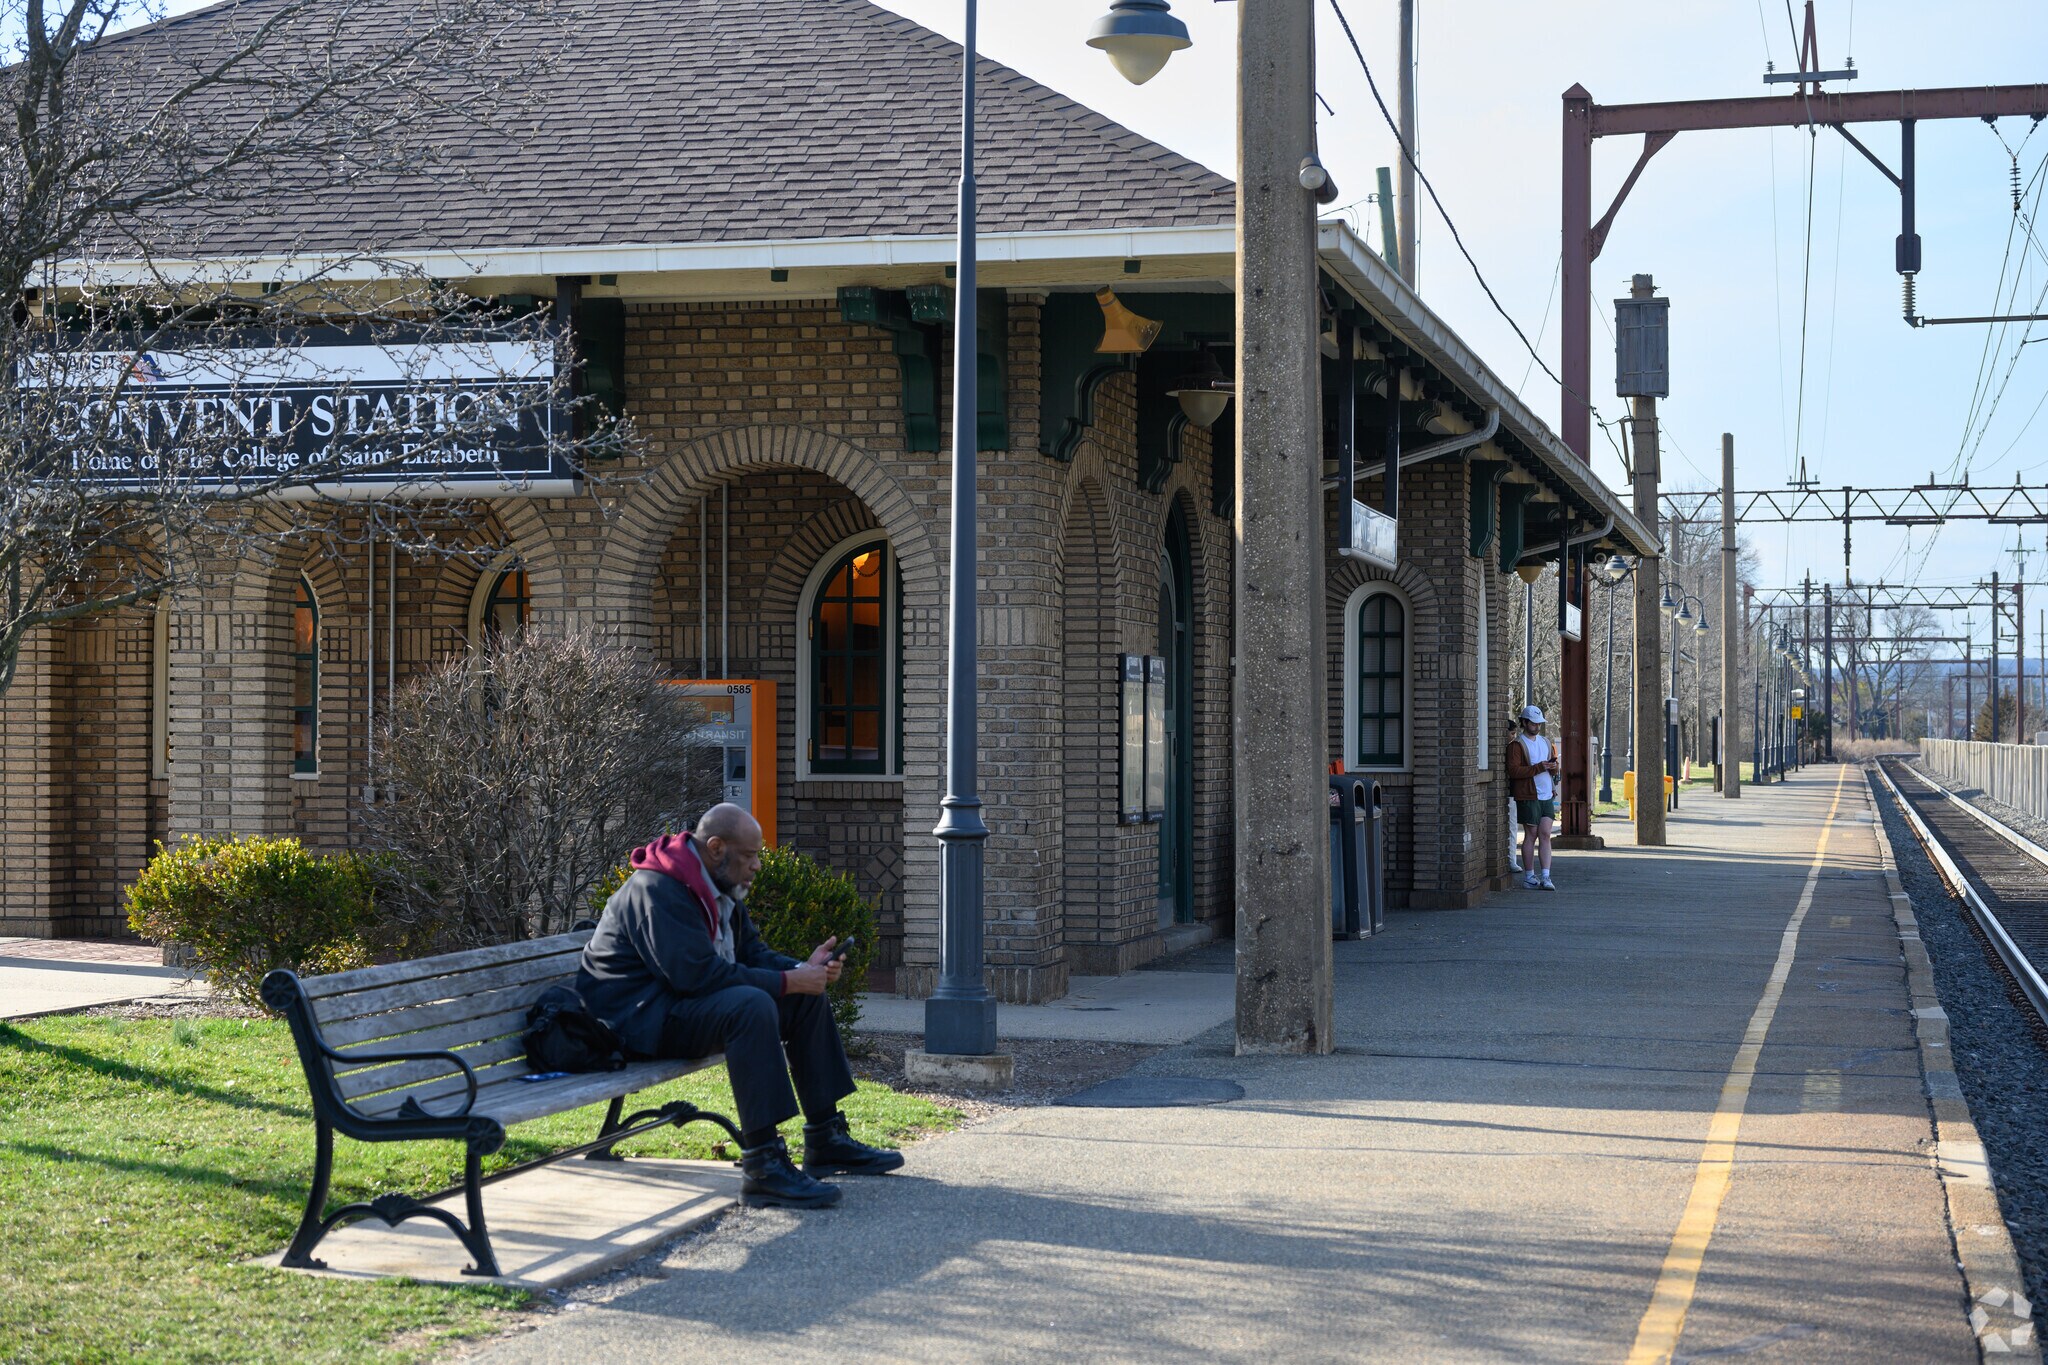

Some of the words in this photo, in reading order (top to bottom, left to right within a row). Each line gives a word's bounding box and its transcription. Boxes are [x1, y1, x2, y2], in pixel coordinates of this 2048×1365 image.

[49, 396, 293, 442] CONVENT
[311, 390, 522, 436] STATION
[71, 449, 133, 471] Home
[140, 448, 161, 470] of
[171, 446, 214, 469] The
[222, 445, 300, 473] College
[308, 443, 331, 466] of
[339, 442, 392, 466] Saint
[402, 440, 500, 466] Elizabeth
[727, 685, 751, 694] 0585
